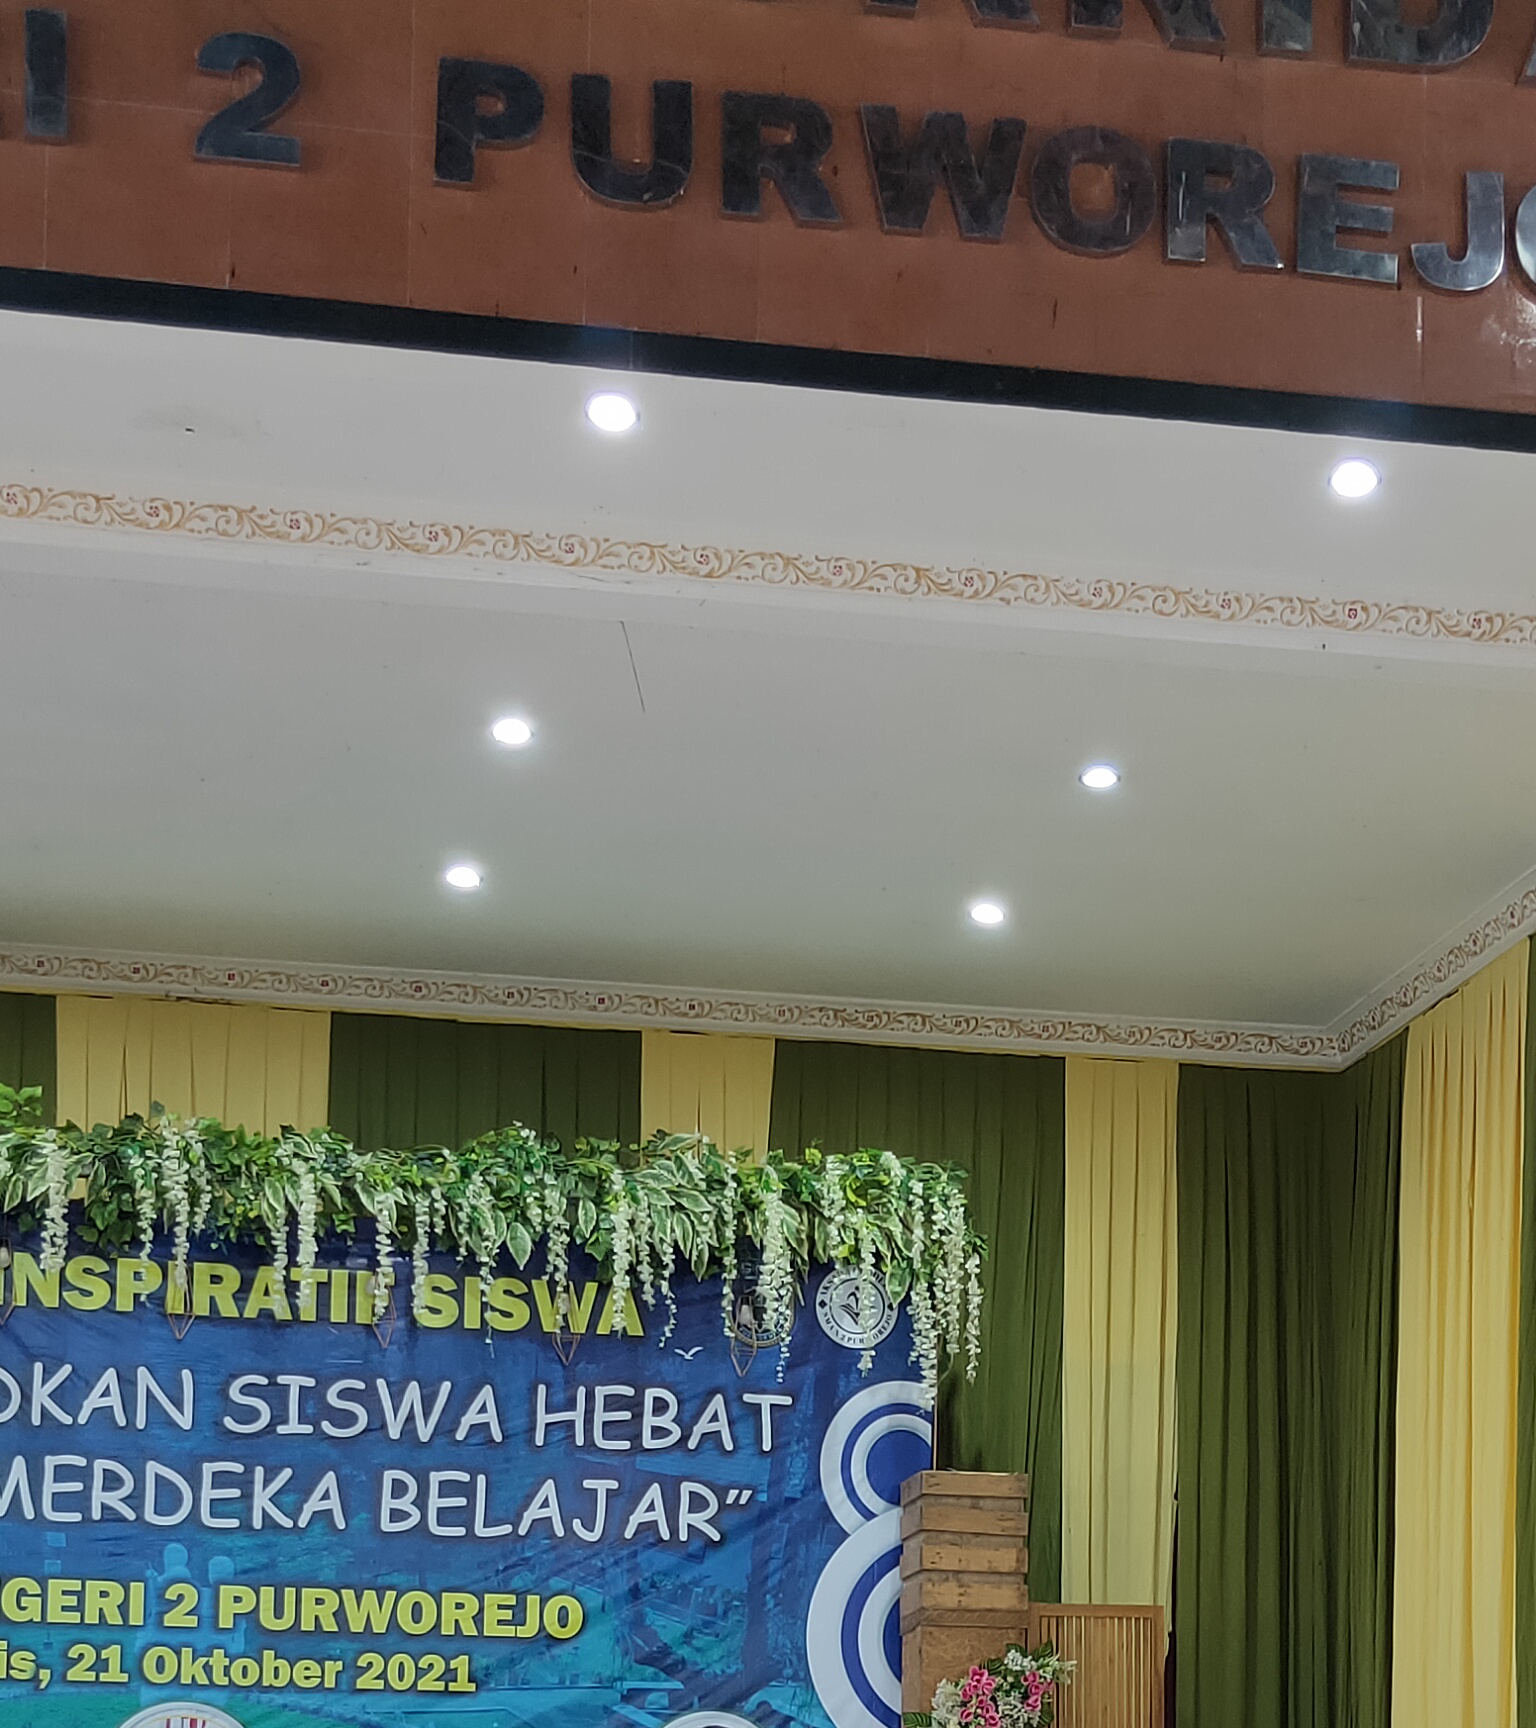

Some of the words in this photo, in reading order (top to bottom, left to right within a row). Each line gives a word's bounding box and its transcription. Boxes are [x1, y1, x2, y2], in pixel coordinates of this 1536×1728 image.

[194, 32, 302, 168] 2
[414, 1272, 644, 1337] SISWA
[223, 1374, 502, 1444] SISWA
[534, 1382, 793, 1452] HEBAT
[380, 1469, 752, 1542] BELAJAR”
[163, 1583, 199, 1628] 2
[219, 1585, 585, 1640] PURWOREJO
[67, 1644, 129, 1683] 21
[143, 1646, 342, 1689] Oktober
[355, 1652, 477, 1692] 2021
